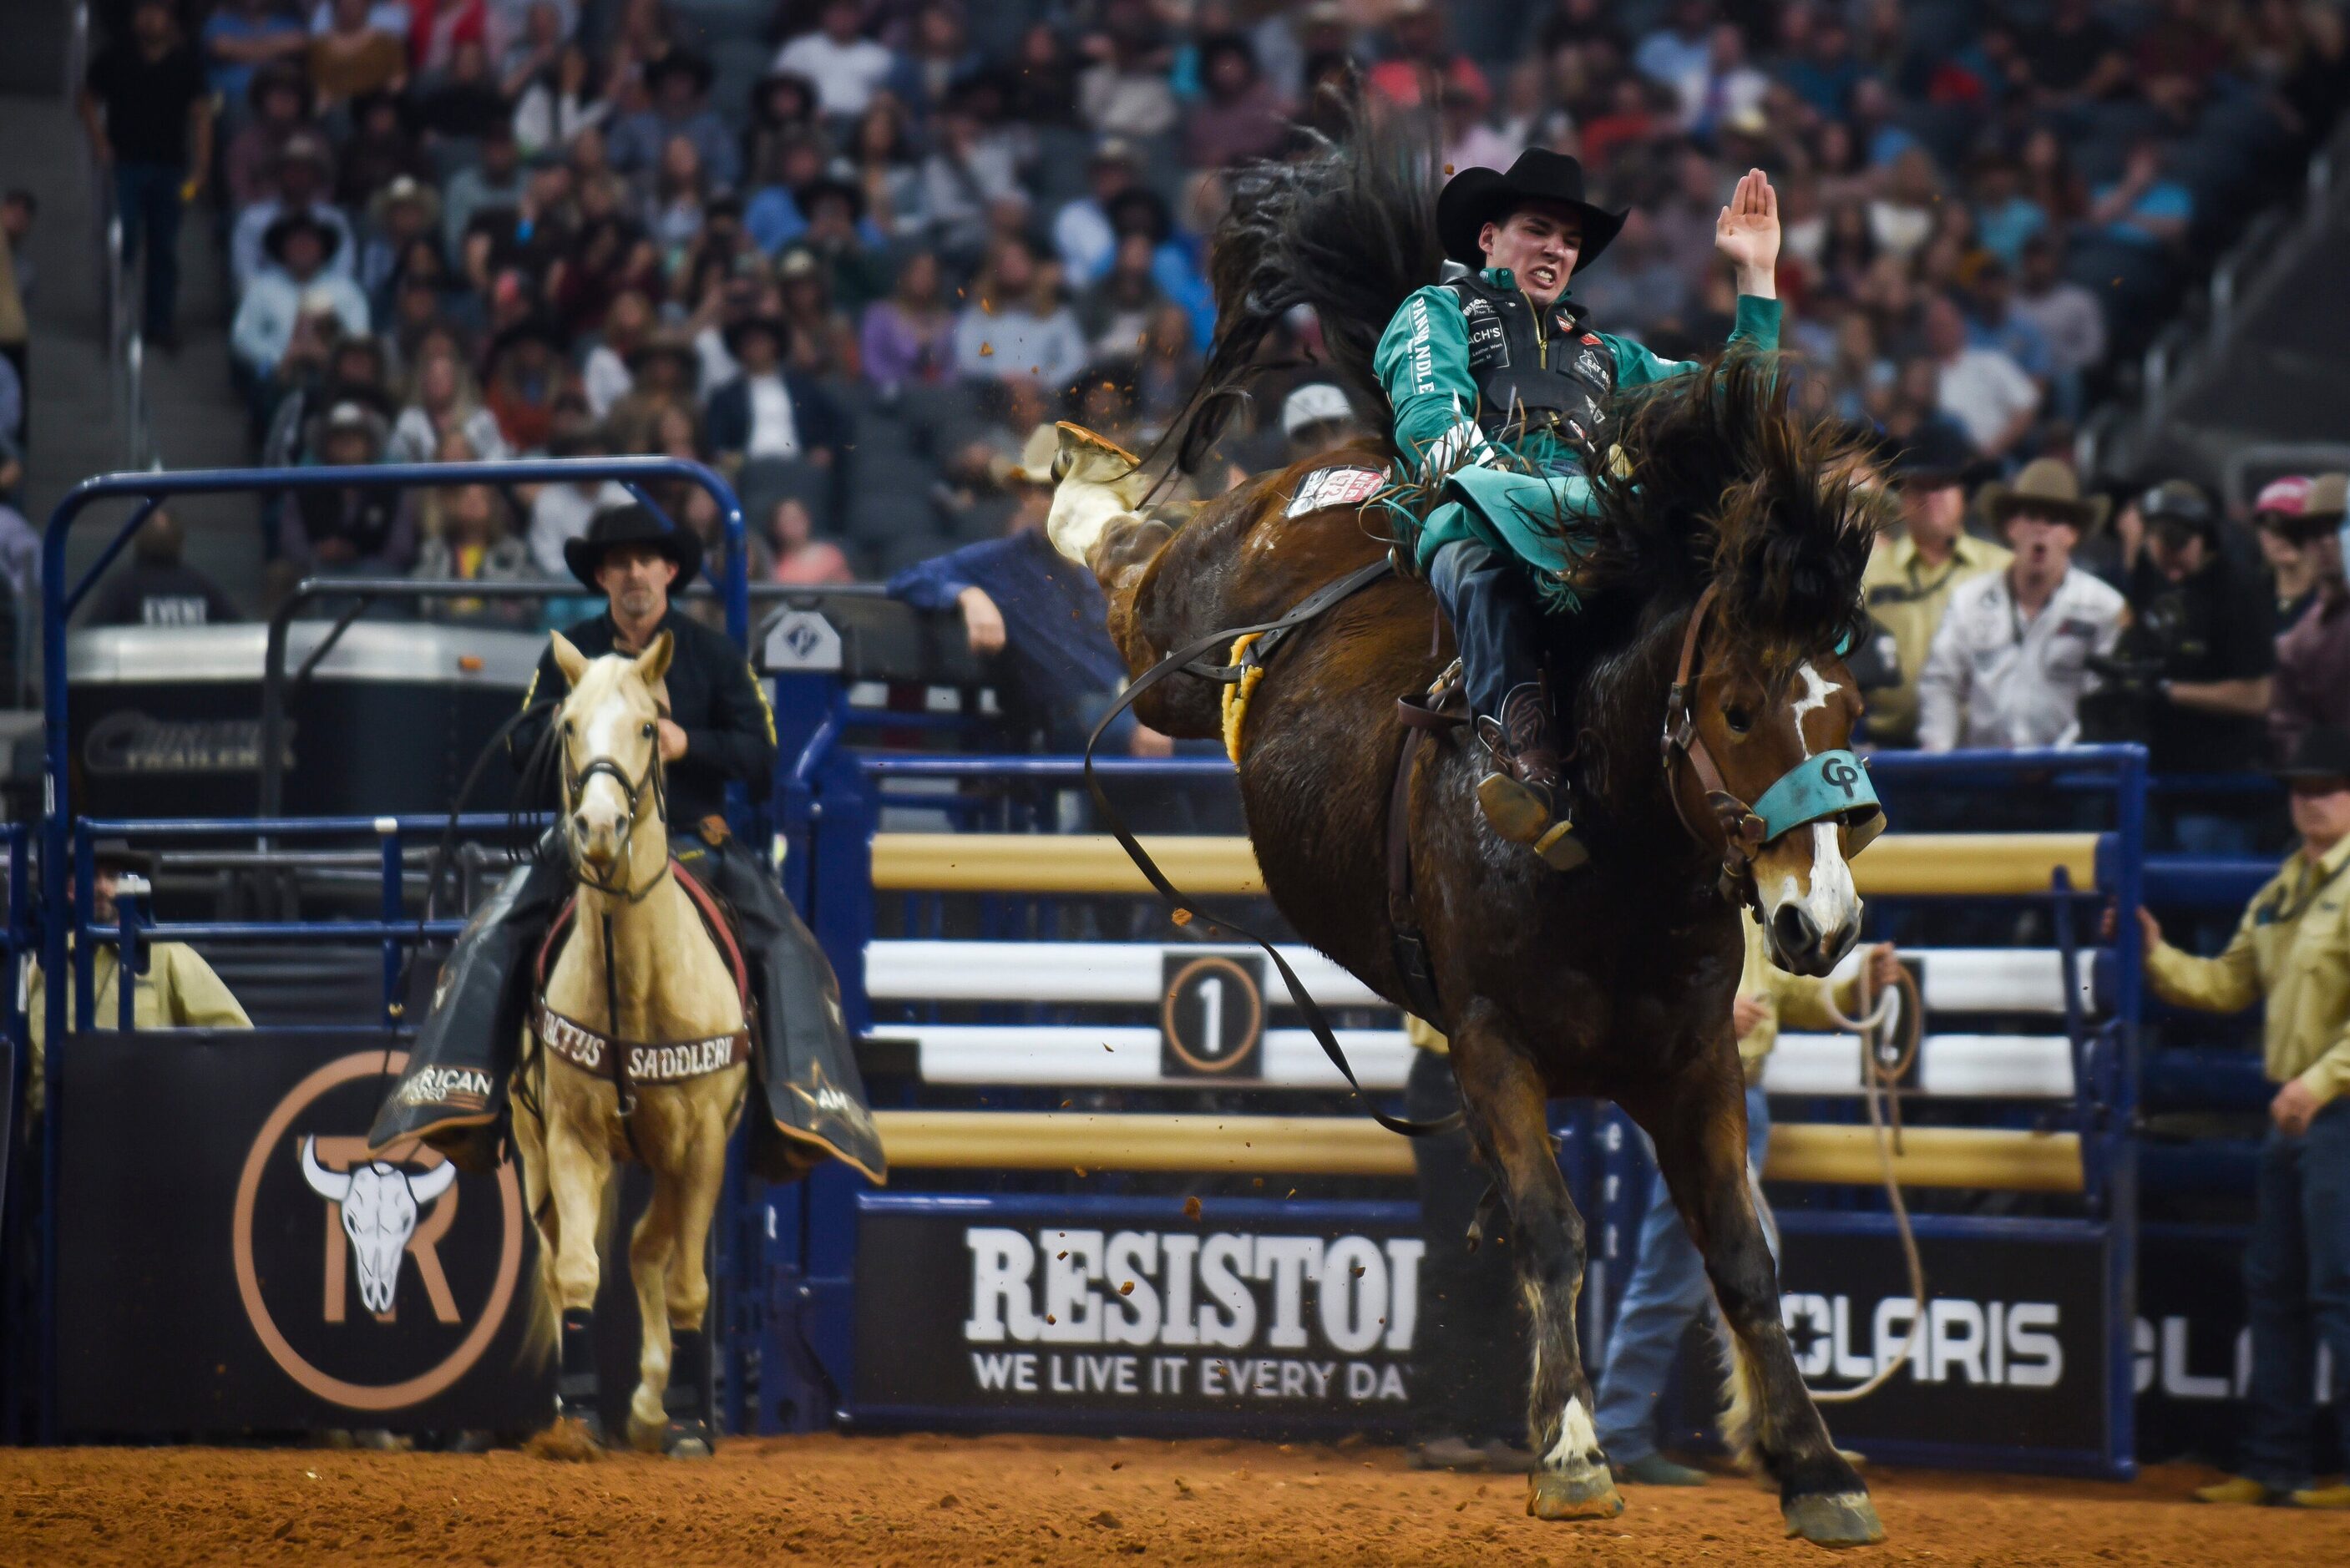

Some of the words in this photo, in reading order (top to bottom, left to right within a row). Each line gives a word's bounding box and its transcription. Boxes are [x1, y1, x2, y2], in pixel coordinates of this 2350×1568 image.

[1412, 296, 1436, 395] PANHANDLE
[1468, 327, 1502, 344] ACH'S
[1587, 358, 1602, 373] EAT
[1822, 758, 1859, 798] CP
[1198, 976, 1223, 1055] 1
[403, 1065, 494, 1096] RICAN
[1780, 1293, 2063, 1387] OLARIS
[972, 1353, 1038, 1392] WE
[1050, 1354, 1138, 1393] LIVE
[1152, 1357, 1188, 1394] IT
[1201, 1358, 1335, 1399] EVERY
[1348, 1362, 1412, 1401] DA
